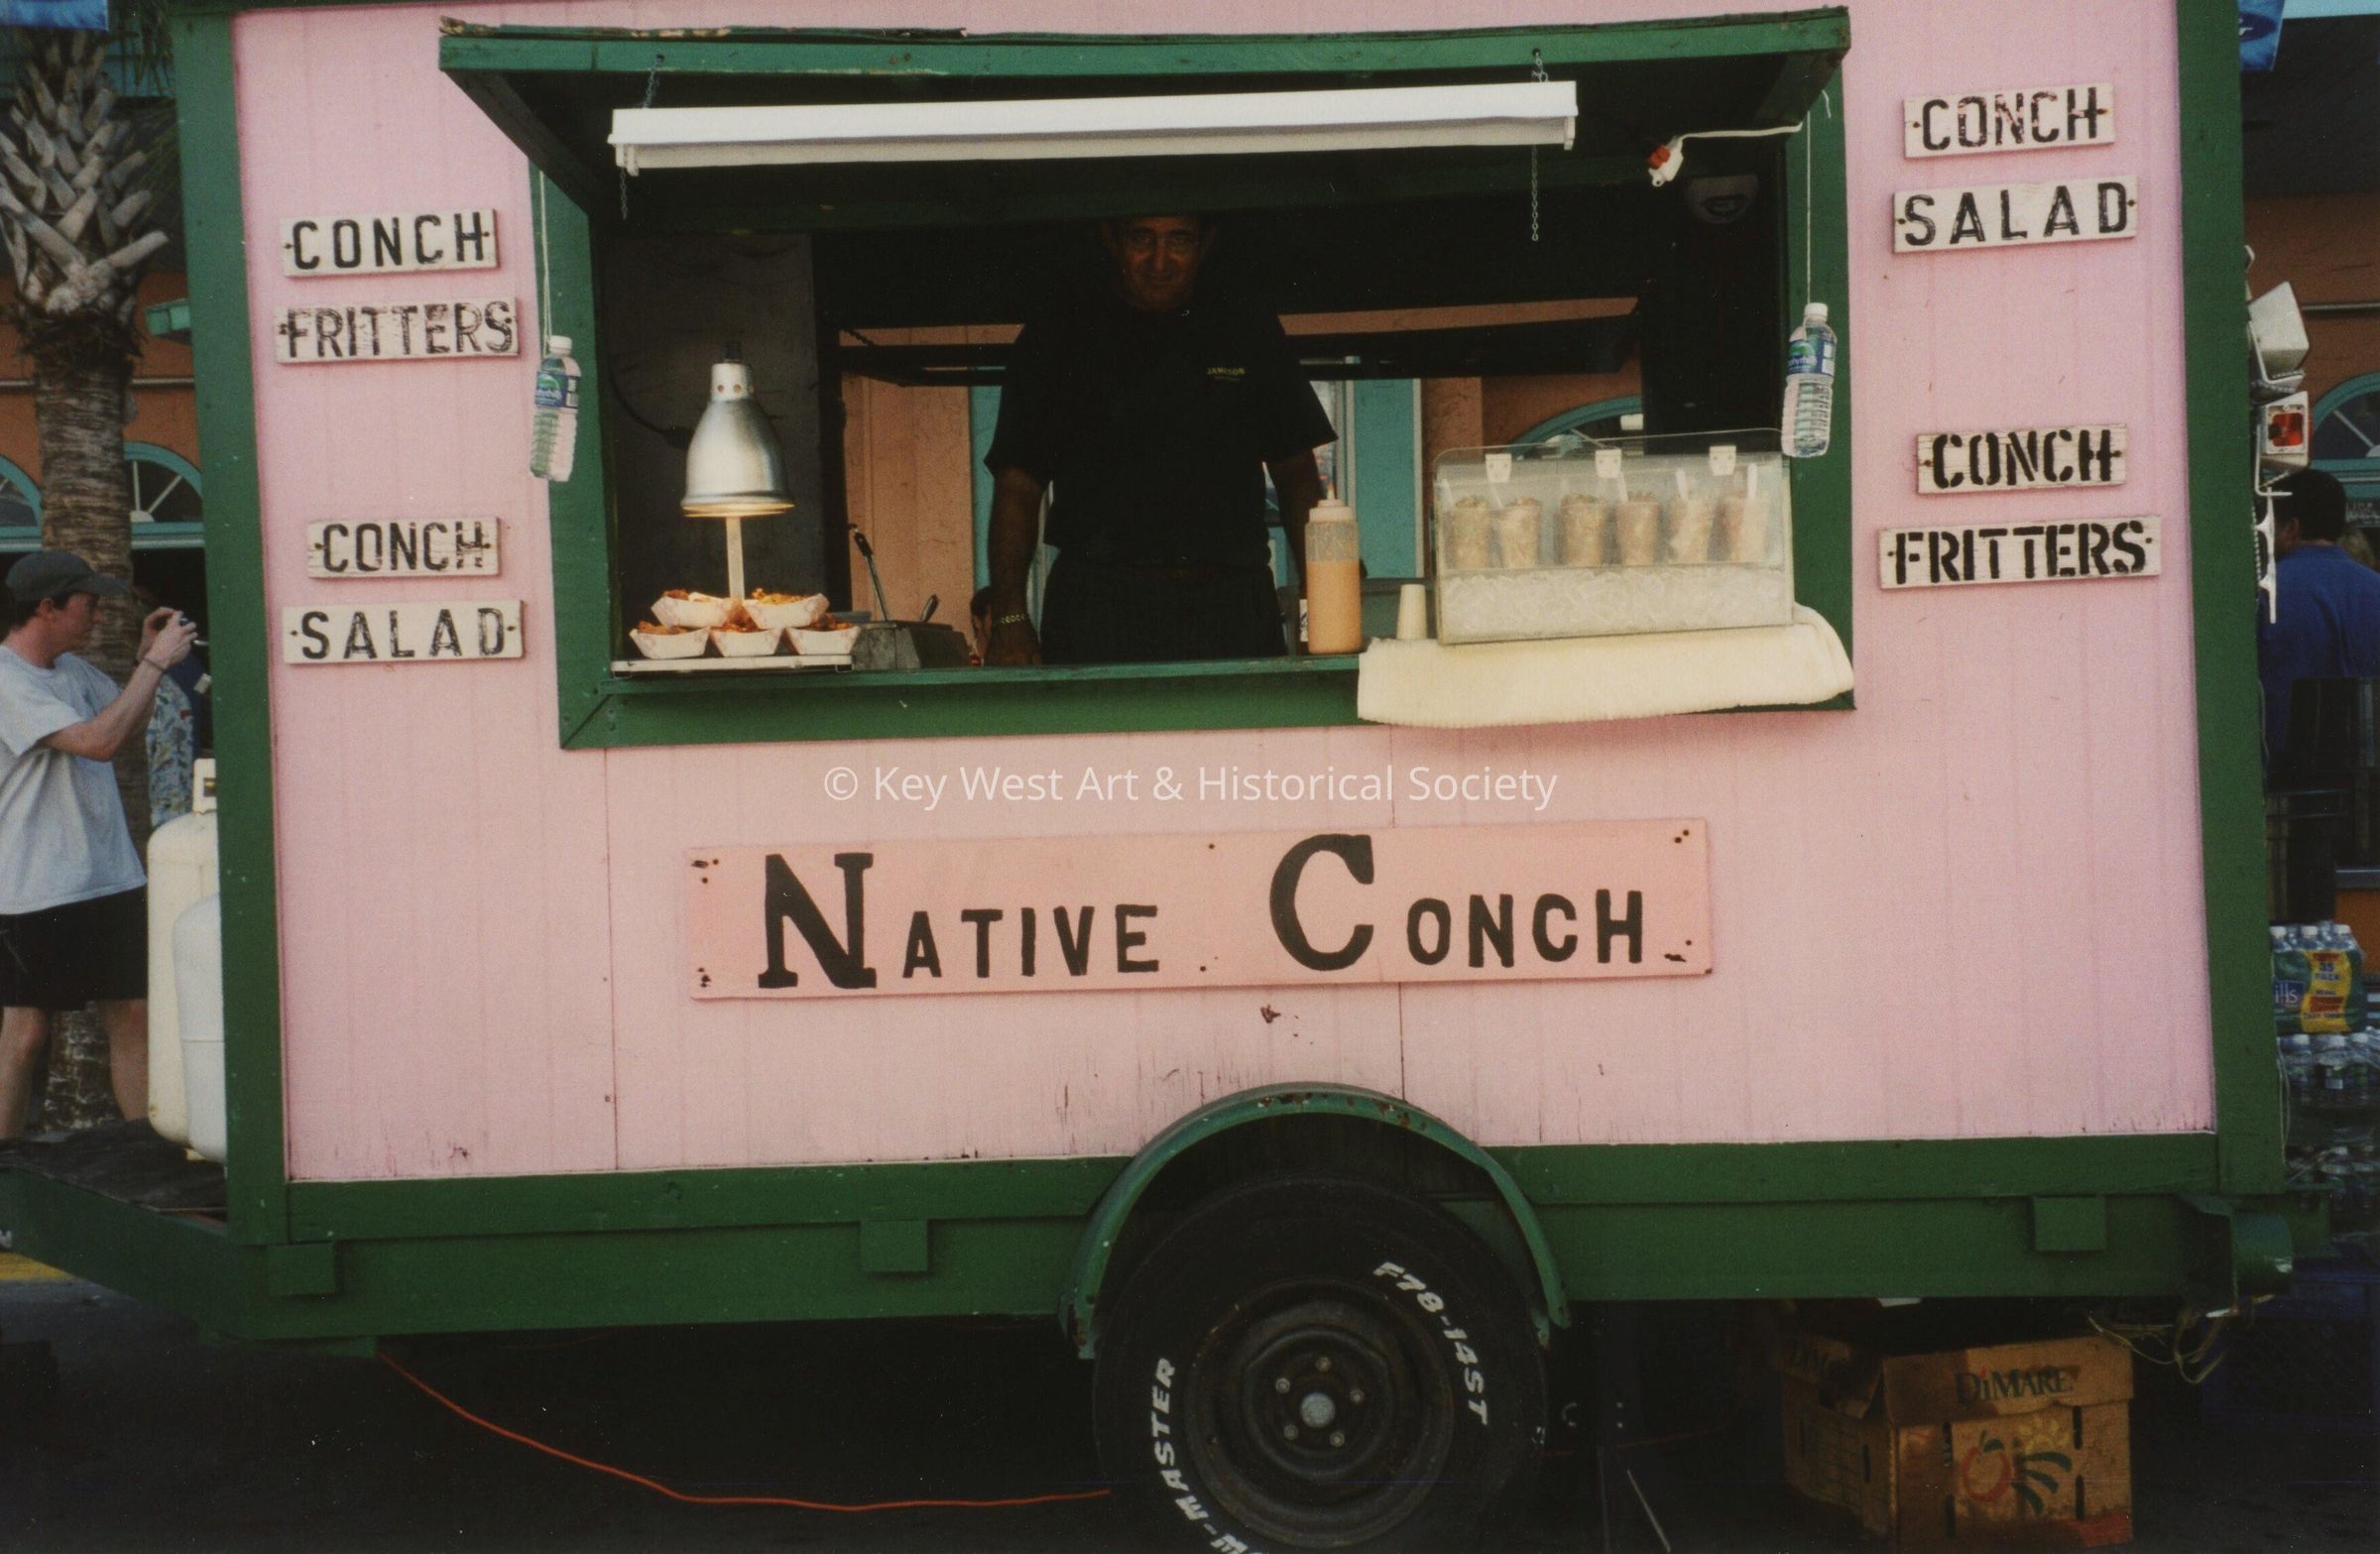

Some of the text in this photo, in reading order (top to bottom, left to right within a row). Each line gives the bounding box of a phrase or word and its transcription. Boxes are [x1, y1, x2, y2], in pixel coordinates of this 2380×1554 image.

[1922, 87, 2100, 150] CONCH
[293, 211, 486, 270] CONCH
[1904, 181, 2129, 246] SALAD
[286, 300, 514, 359] FRITTERS
[1931, 429, 2113, 488] CONCH
[322, 522, 484, 573] CONCH
[1894, 521, 2147, 584] FRITTERS
[301, 607, 505, 659] SALAD
[759, 833, 1643, 990] NATIVE CONCH
[1150, 1357, 1262, 1554] W-MASTER
